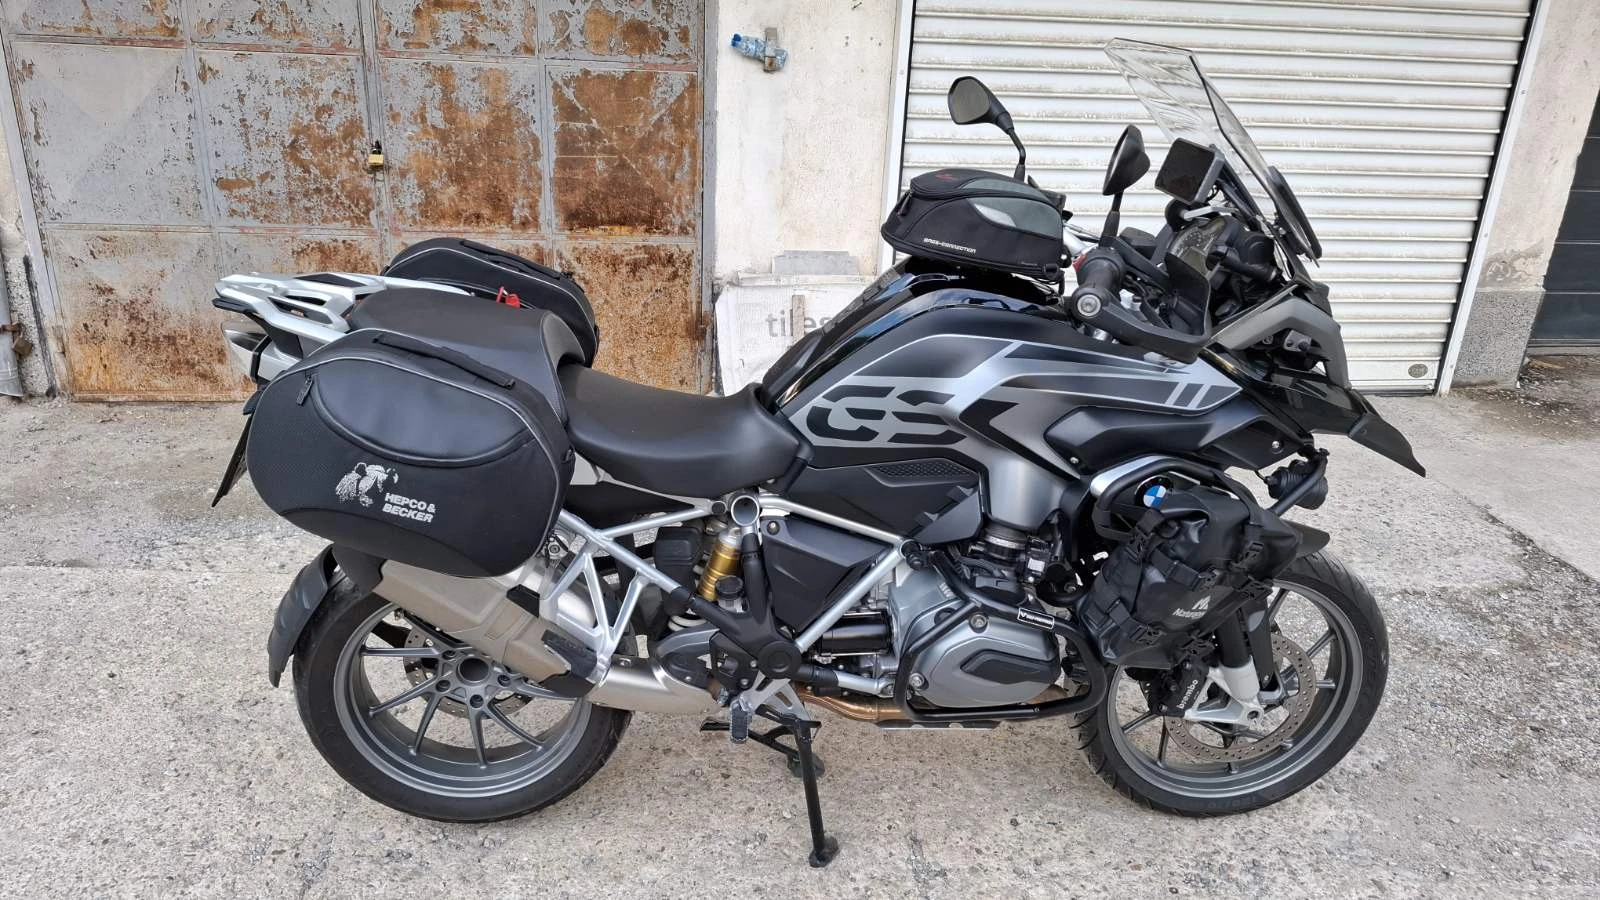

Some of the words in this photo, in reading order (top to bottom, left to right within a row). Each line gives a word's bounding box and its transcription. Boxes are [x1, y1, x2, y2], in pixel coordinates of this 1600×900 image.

[806, 384, 968, 445] GS
[382, 502, 434, 523] BECKER
[1176, 679, 1199, 709] brembo
